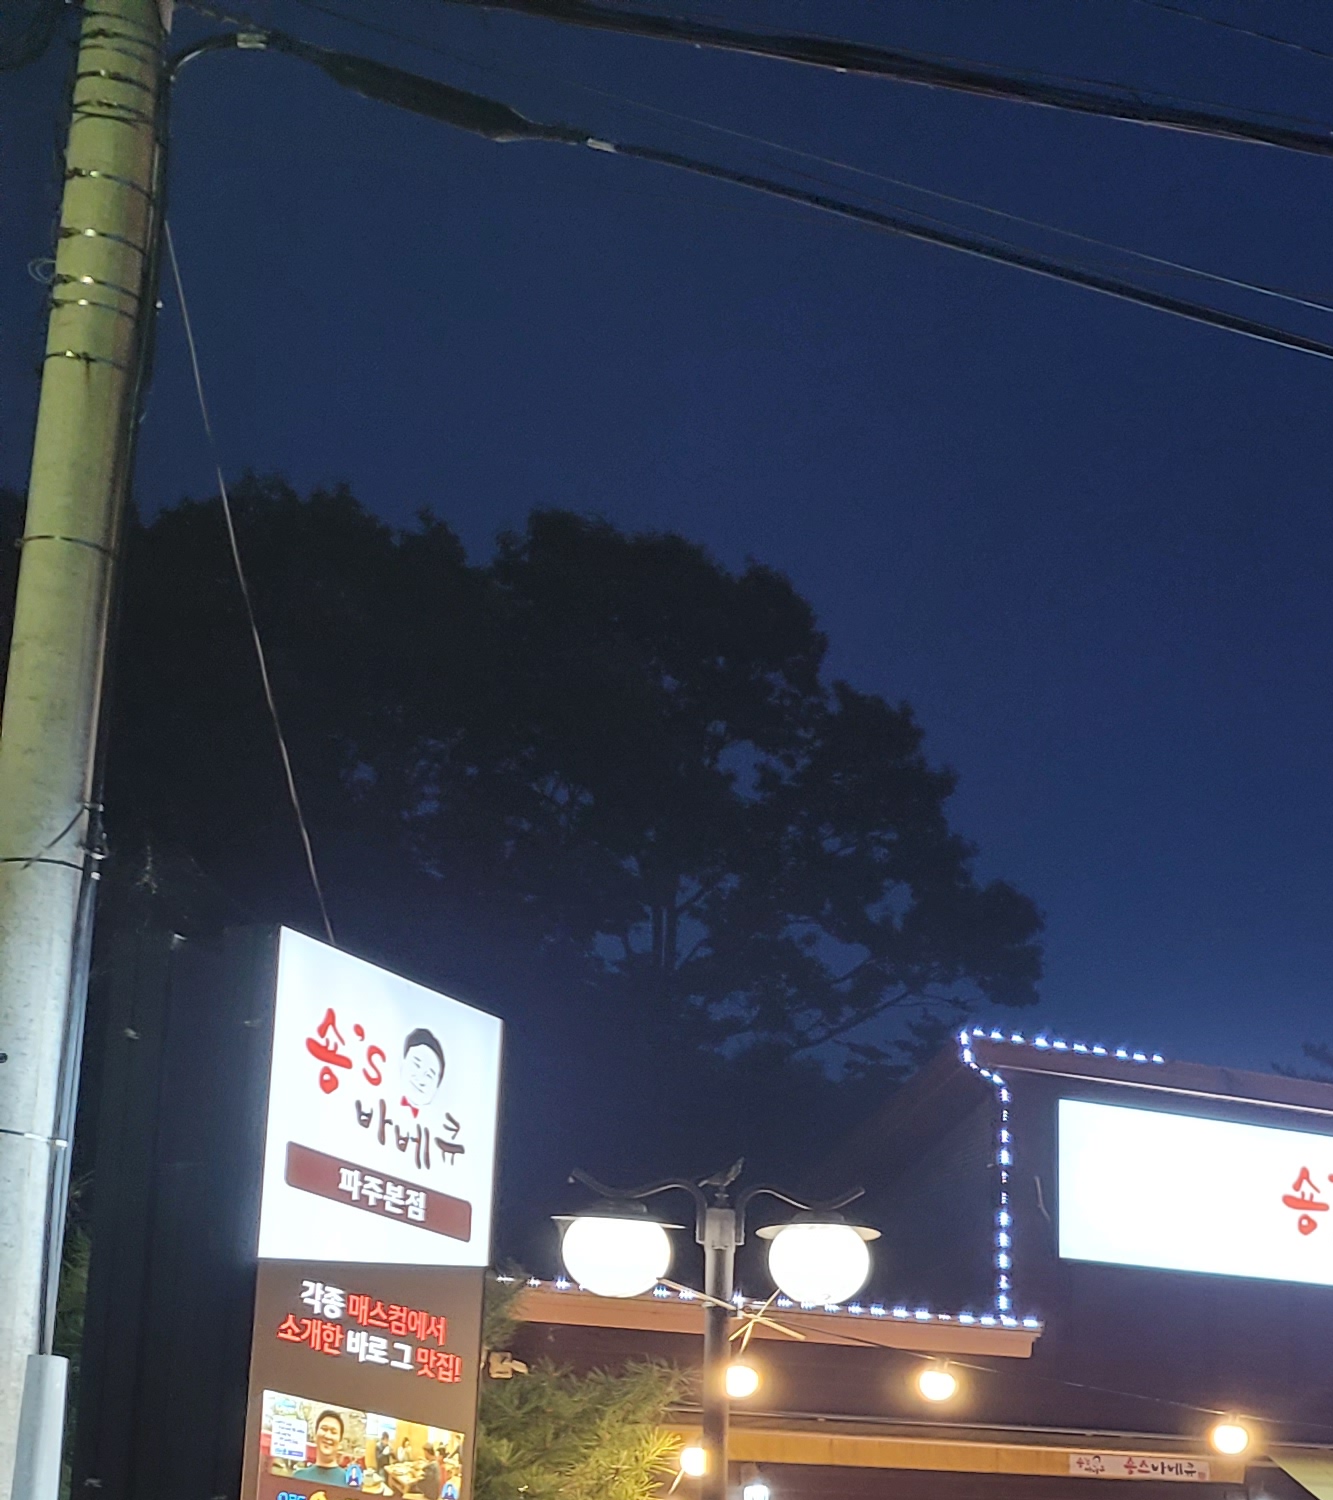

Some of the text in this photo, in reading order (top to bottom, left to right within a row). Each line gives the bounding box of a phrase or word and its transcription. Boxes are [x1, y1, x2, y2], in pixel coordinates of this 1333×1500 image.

[305, 1007, 387, 1094] 송's
[354, 1098, 466, 1170] 바베큐
[338, 1166, 427, 1222] 파주본점
[300, 1280, 447, 1346] 각종 매스컴에서
[277, 1313, 344, 1355] 소개한
[416, 1347, 463, 1383] 맛집!
[1123, 1457, 1197, 1476] 송스바베큐
